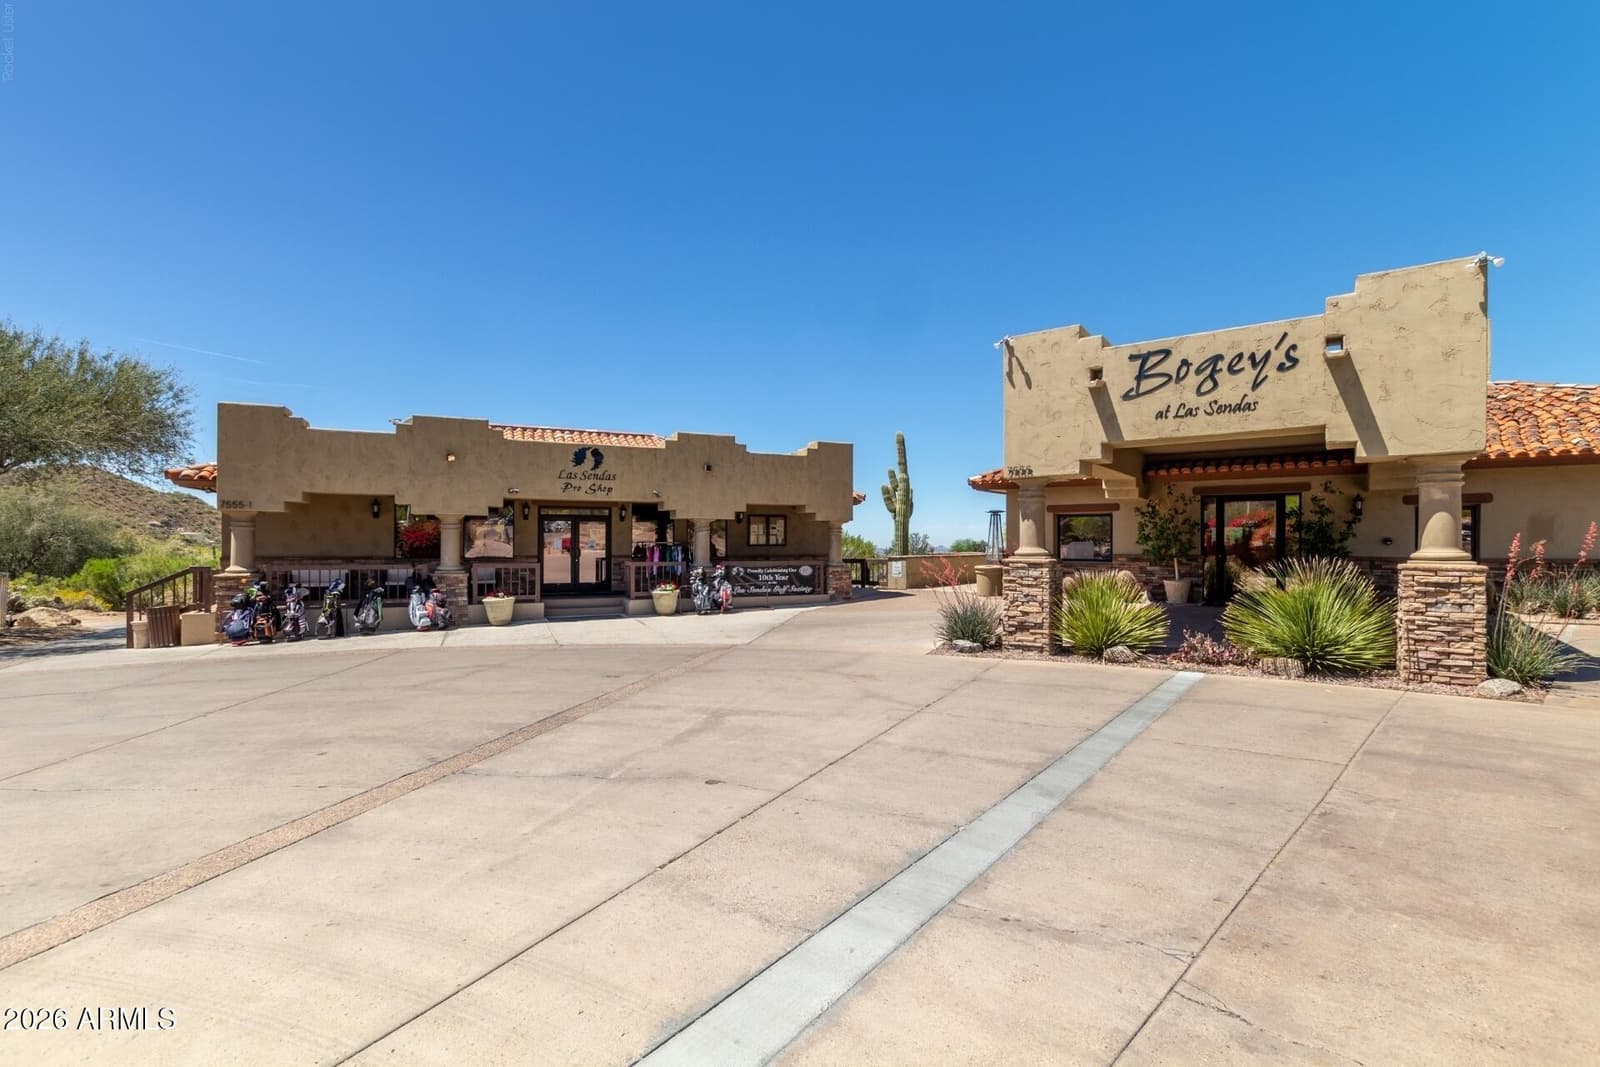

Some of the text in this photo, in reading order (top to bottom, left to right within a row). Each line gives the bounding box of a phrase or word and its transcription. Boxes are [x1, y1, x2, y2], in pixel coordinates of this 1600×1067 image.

[1120, 331, 1301, 401] Bogey's
[1155, 393, 1259, 421] at Las Sendas
[558, 468, 617, 481] Las Sendas
[560, 481, 614, 496] Pro Shop
[774, 573, 789, 581] Year
